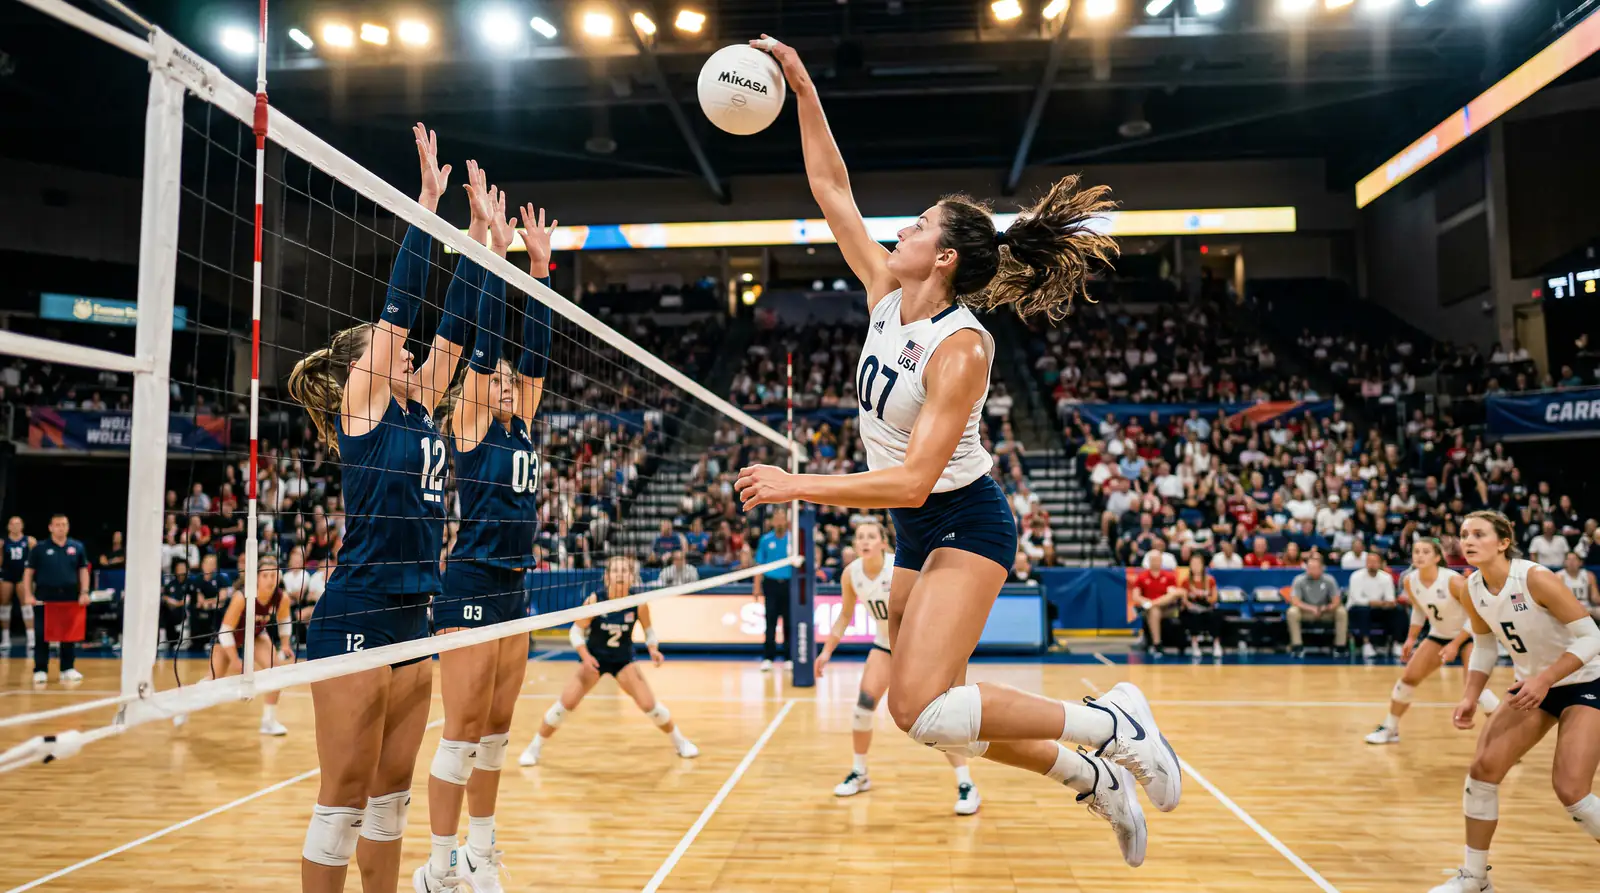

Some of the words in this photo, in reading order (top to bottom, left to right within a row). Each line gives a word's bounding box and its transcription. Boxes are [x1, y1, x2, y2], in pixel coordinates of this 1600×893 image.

[897, 355, 917, 373] USA
[859, 355, 899, 420] 07
[420, 437, 446, 491] 12
[512, 450, 541, 493] 03
[463, 605, 483, 621] 03
[868, 600, 888, 620] 10
[1427, 604, 1443, 621] 2
[1513, 603, 1529, 612] USA
[346, 633, 366, 652] 12
[607, 630, 622, 648] 2
[1500, 621, 1528, 654] 5
